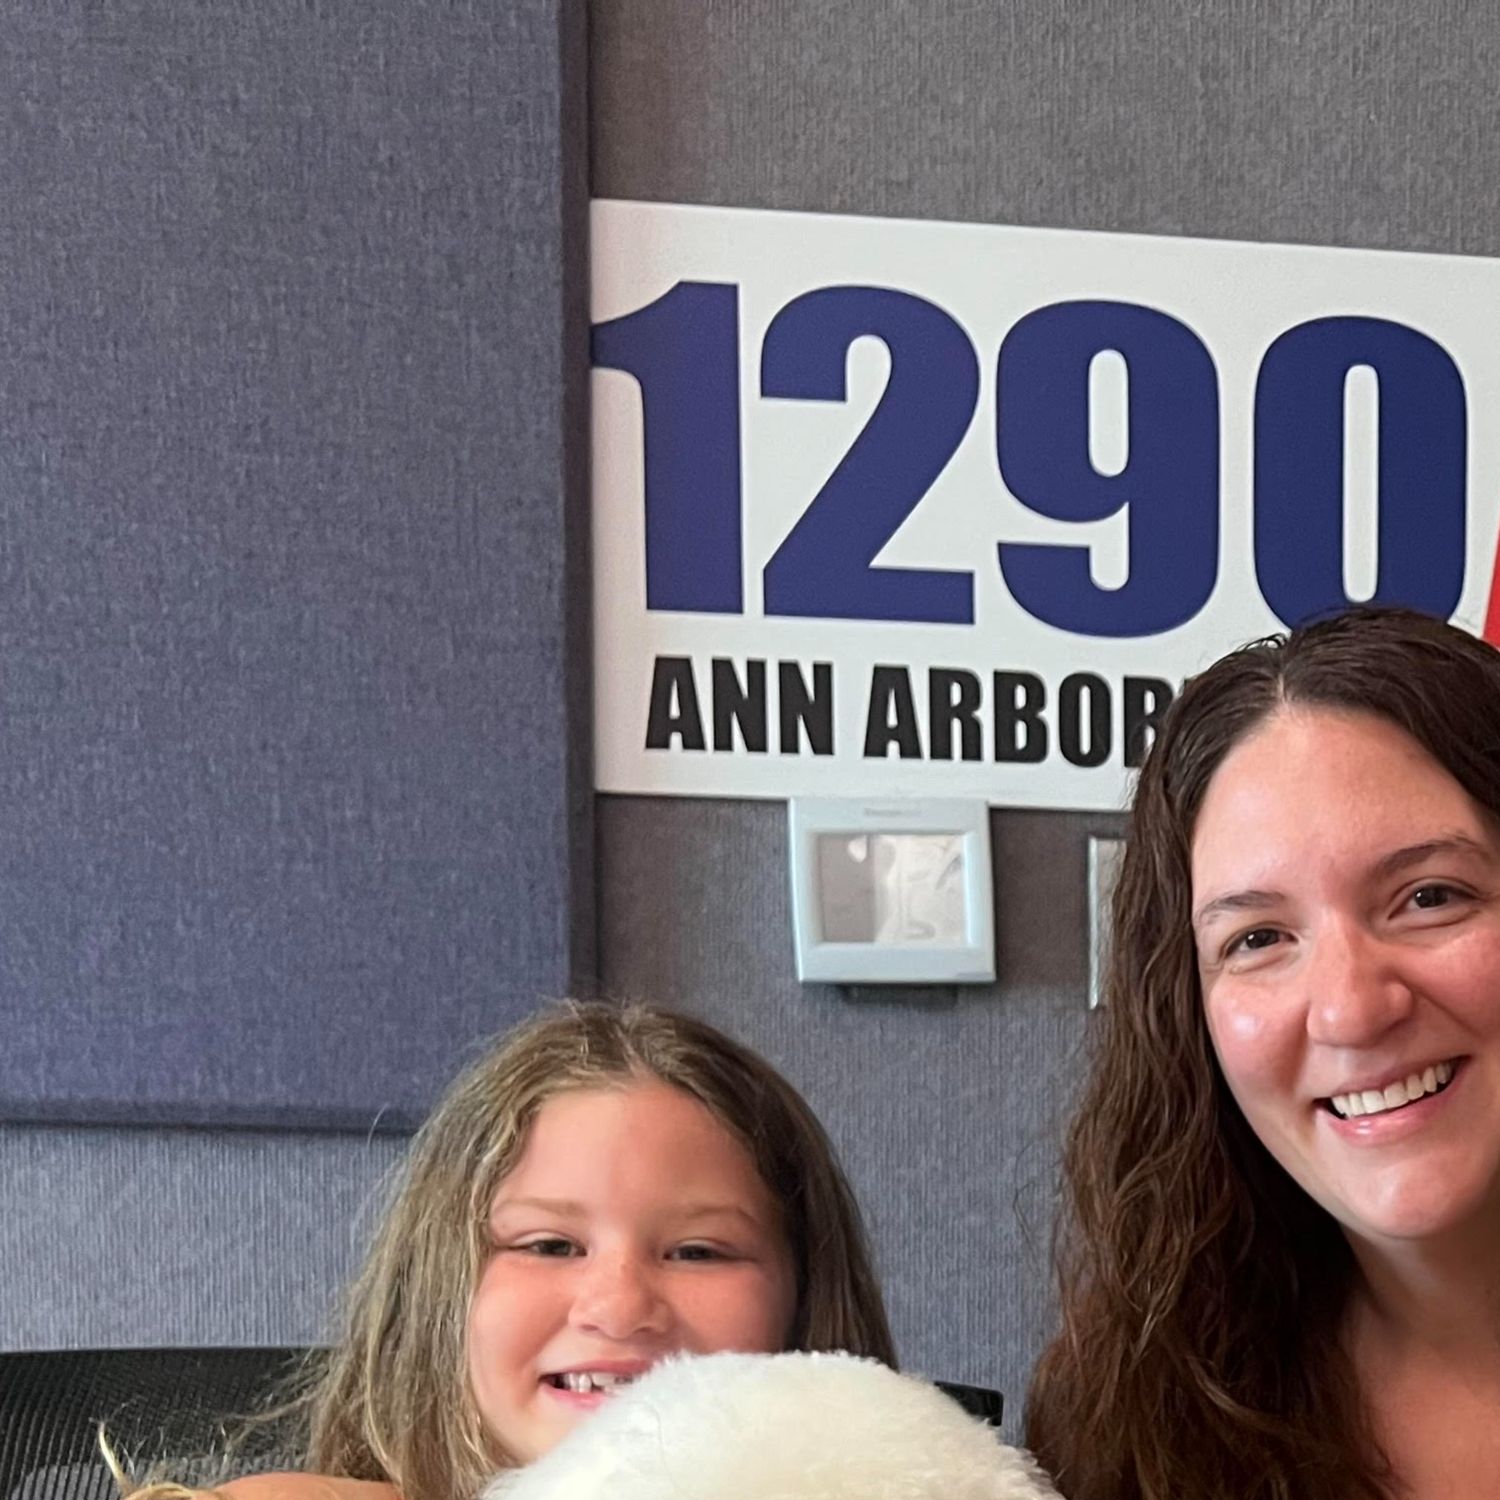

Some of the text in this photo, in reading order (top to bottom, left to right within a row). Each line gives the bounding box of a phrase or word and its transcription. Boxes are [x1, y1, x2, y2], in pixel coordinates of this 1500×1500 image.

[591, 280, 1468, 639] 1290
[644, 655, 835, 756] ANN
[863, 664, 1187, 769] ARBOR
